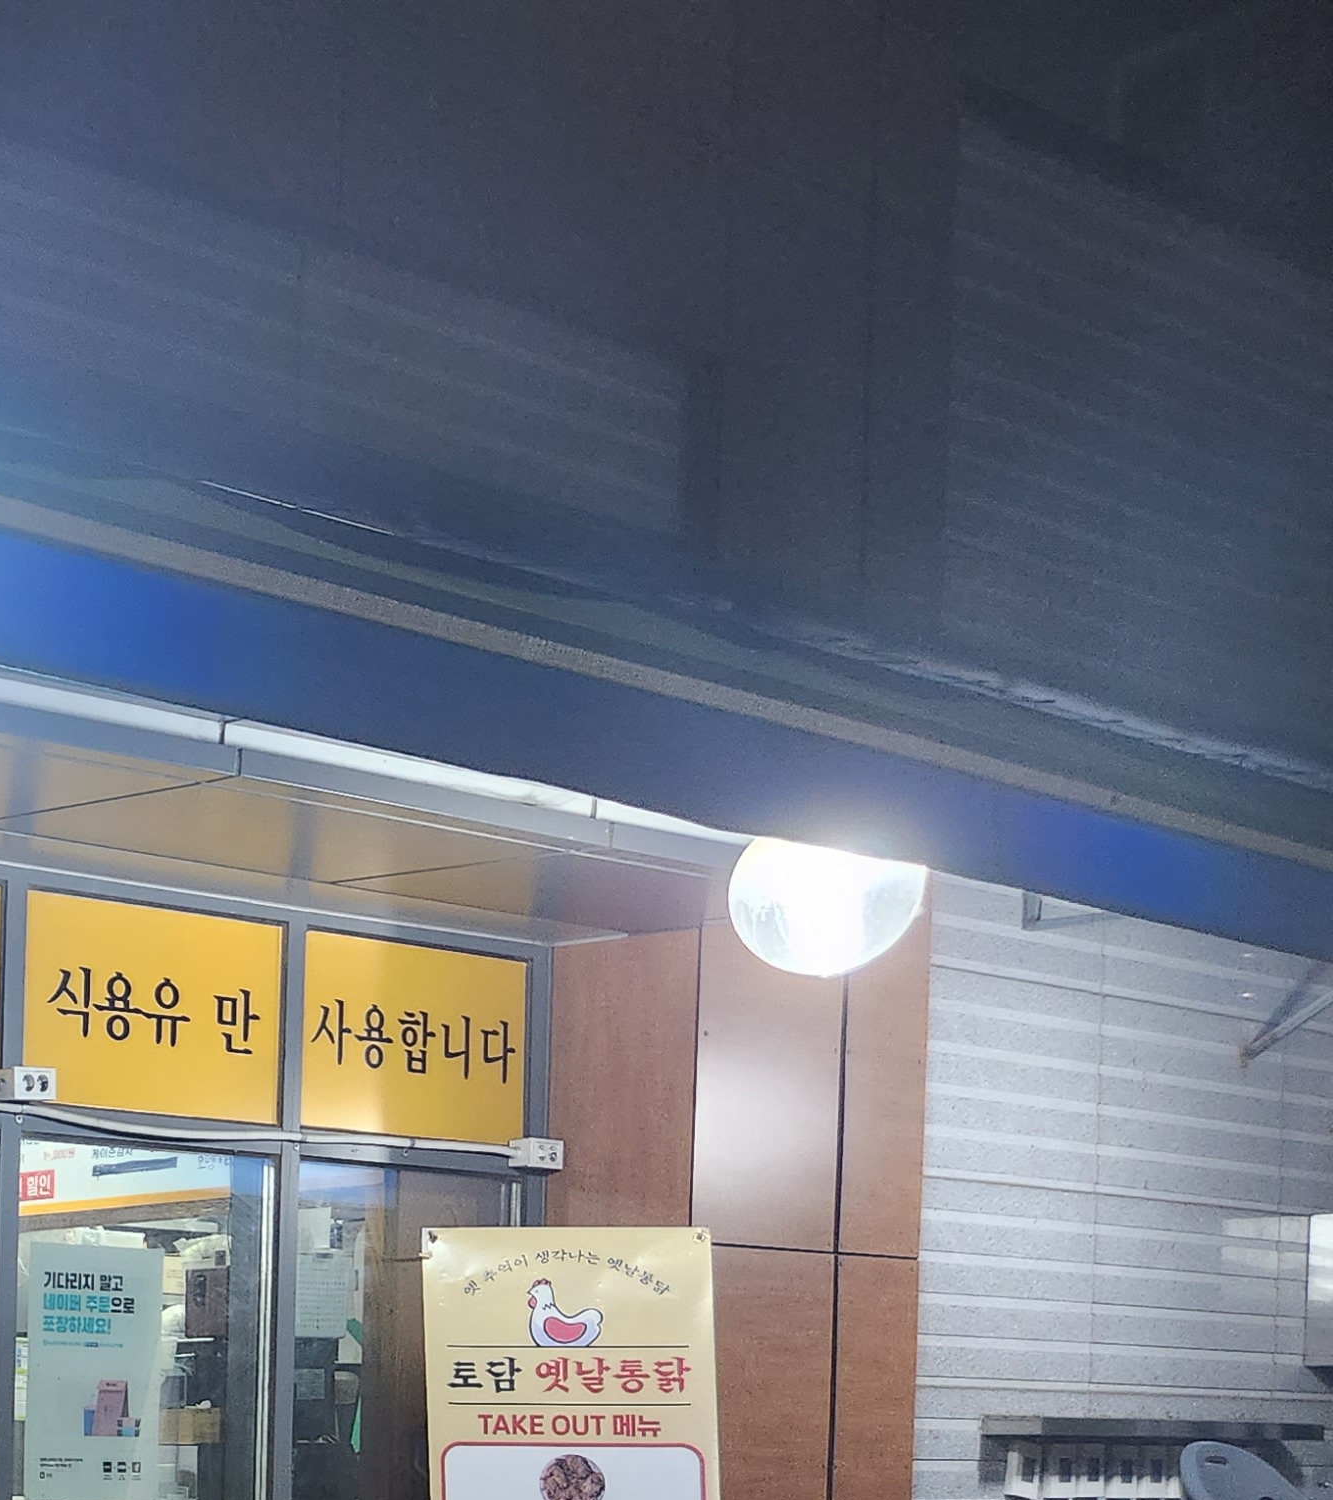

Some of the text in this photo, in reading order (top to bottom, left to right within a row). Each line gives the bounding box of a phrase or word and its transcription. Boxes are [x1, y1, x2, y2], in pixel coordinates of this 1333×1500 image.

[47, 966, 262, 1057] 식용유 만
[310, 999, 516, 1085] 사용합니다
[26, 1174, 51, 1197] 할인
[43, 1271, 124, 1292] 기다리지 말고
[535, 1248, 601, 1266] 생각나는
[606, 1256, 671, 1296] 옛날통닭
[42, 1293, 135, 1314] 네이버 주문으로
[42, 1315, 112, 1335] 포장하세요!
[447, 1356, 692, 1394] 토담 옛날통닭
[478, 1413, 662, 1438] TAKE OUT 메뉴
